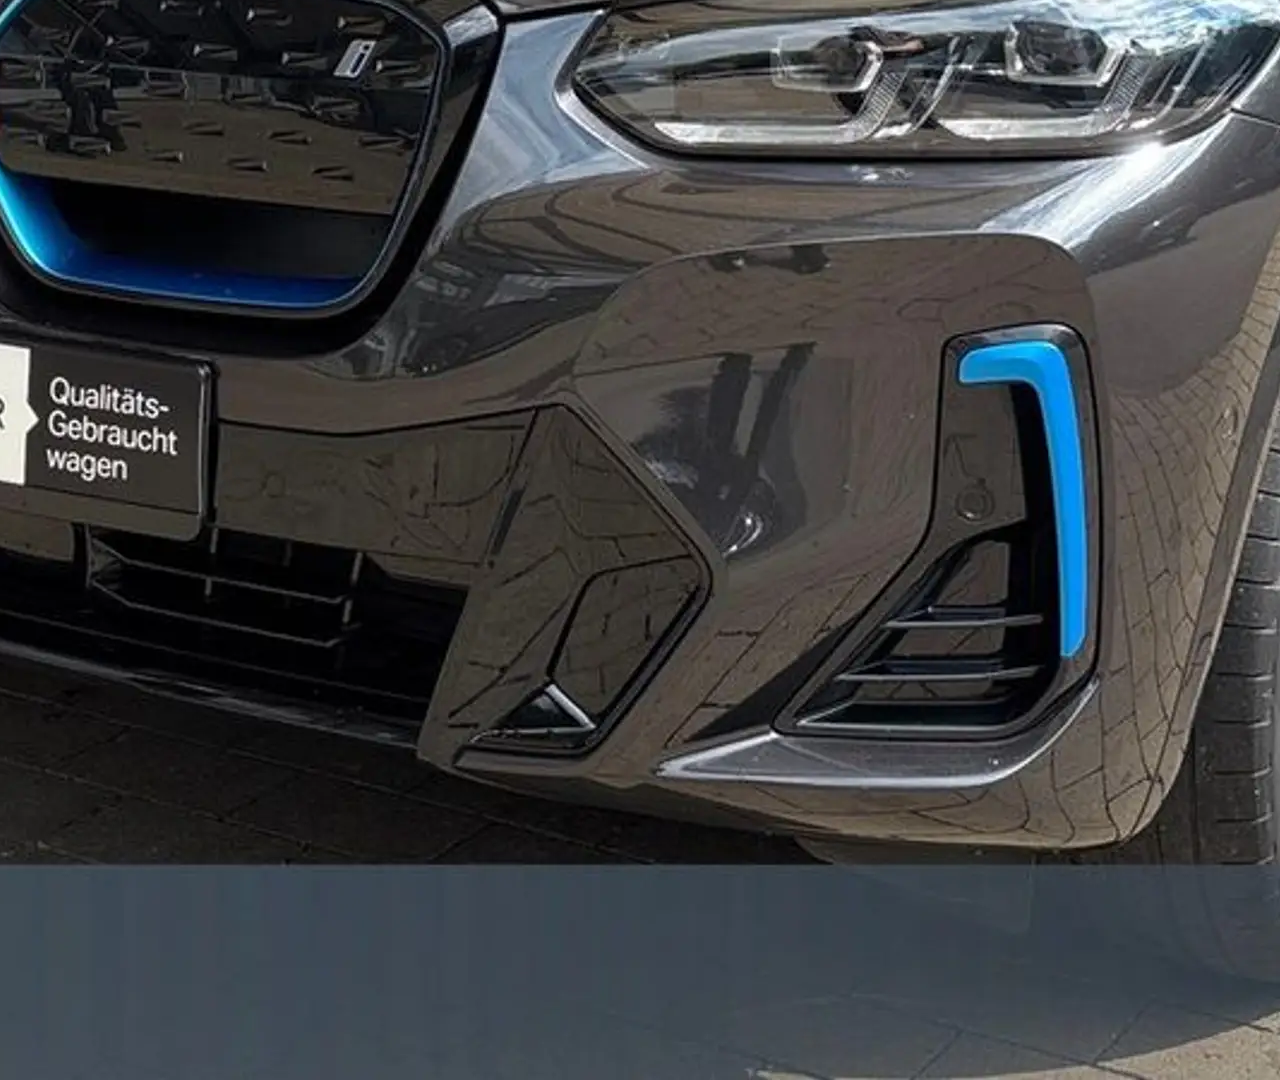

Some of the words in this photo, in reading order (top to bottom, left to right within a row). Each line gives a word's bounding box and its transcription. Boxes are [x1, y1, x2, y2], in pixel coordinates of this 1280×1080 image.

[49, 377, 170, 418] Qualitäts-
[48, 411, 178, 457] Gebraucht
[47, 447, 128, 482] wagen
